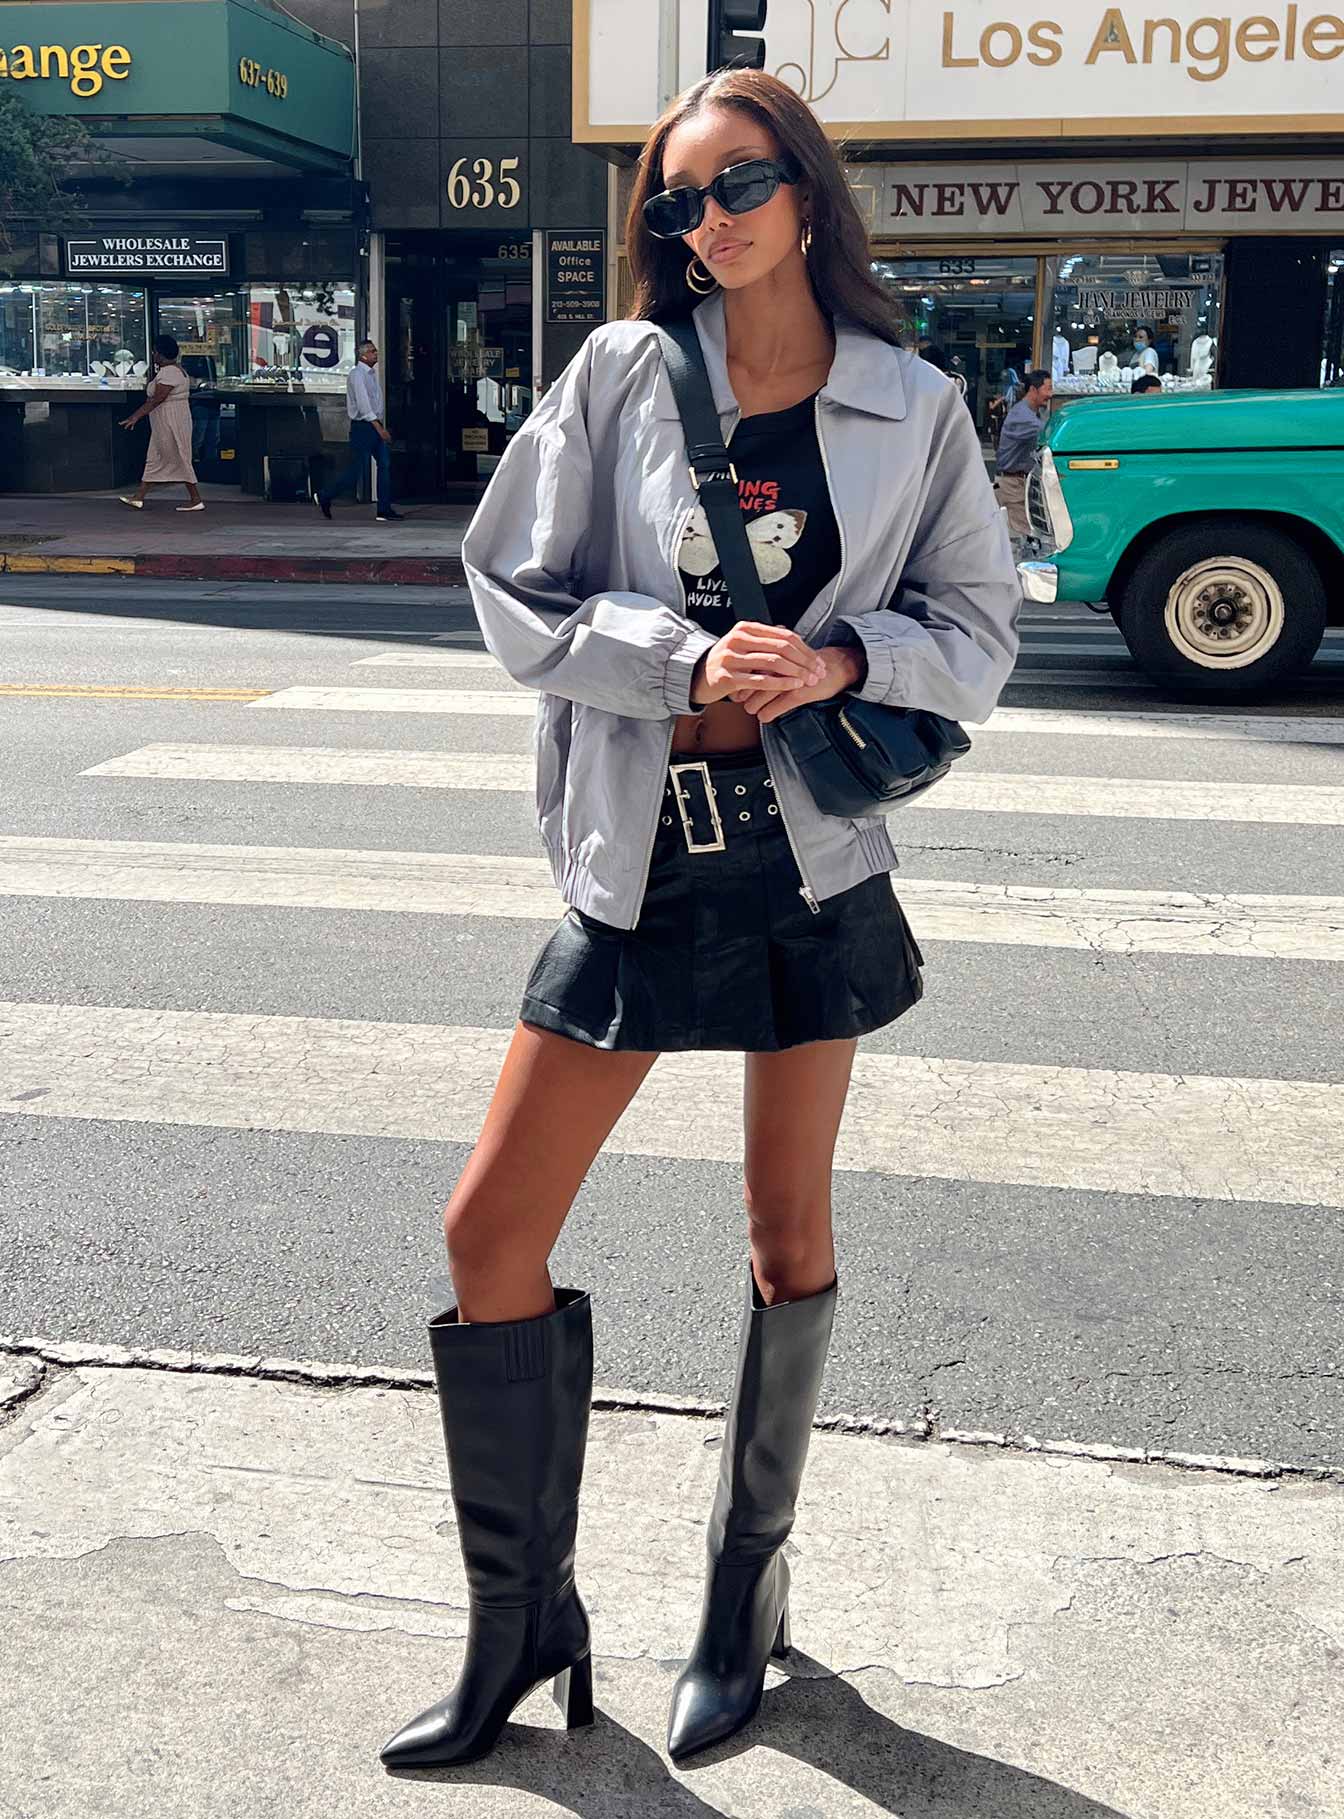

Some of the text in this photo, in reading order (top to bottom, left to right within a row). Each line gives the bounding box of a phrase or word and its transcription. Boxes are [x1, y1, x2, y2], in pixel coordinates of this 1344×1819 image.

[942, 3, 1344, 82] Los Angele
[240, 57, 288, 98] 637-639
[447, 156, 521, 208] 635
[891, 178, 1344, 216] NEW YORK JEWE
[102, 238, 190, 250] WHOLESALE
[551, 240, 601, 252] AVAILABLE
[498, 245, 529, 259] 635
[72, 254, 222, 266] JEWELERS EXCHANGE
[559, 256, 592, 266] Office
[939, 259, 976, 275] 633
[557, 271, 595, 282] SPACE
[1121, 289, 1195, 309] JEWELRY
[696, 577, 729, 592] LIVE
[687, 592, 722, 607] HYDE
